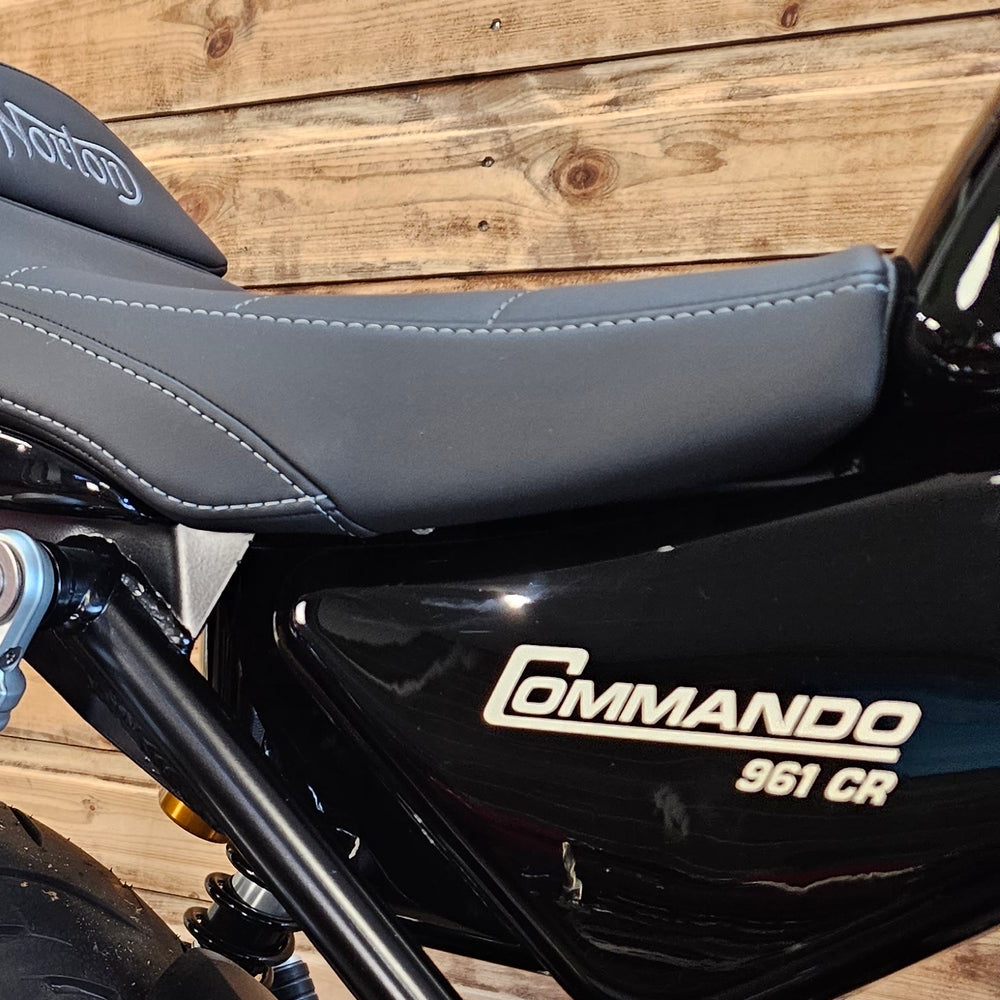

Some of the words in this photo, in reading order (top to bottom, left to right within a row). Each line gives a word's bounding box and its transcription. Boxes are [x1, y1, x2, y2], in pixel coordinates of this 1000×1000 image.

[483, 644, 922, 764] COMMANDO
[735, 758, 821, 798] 961
[824, 766, 899, 806] CR
